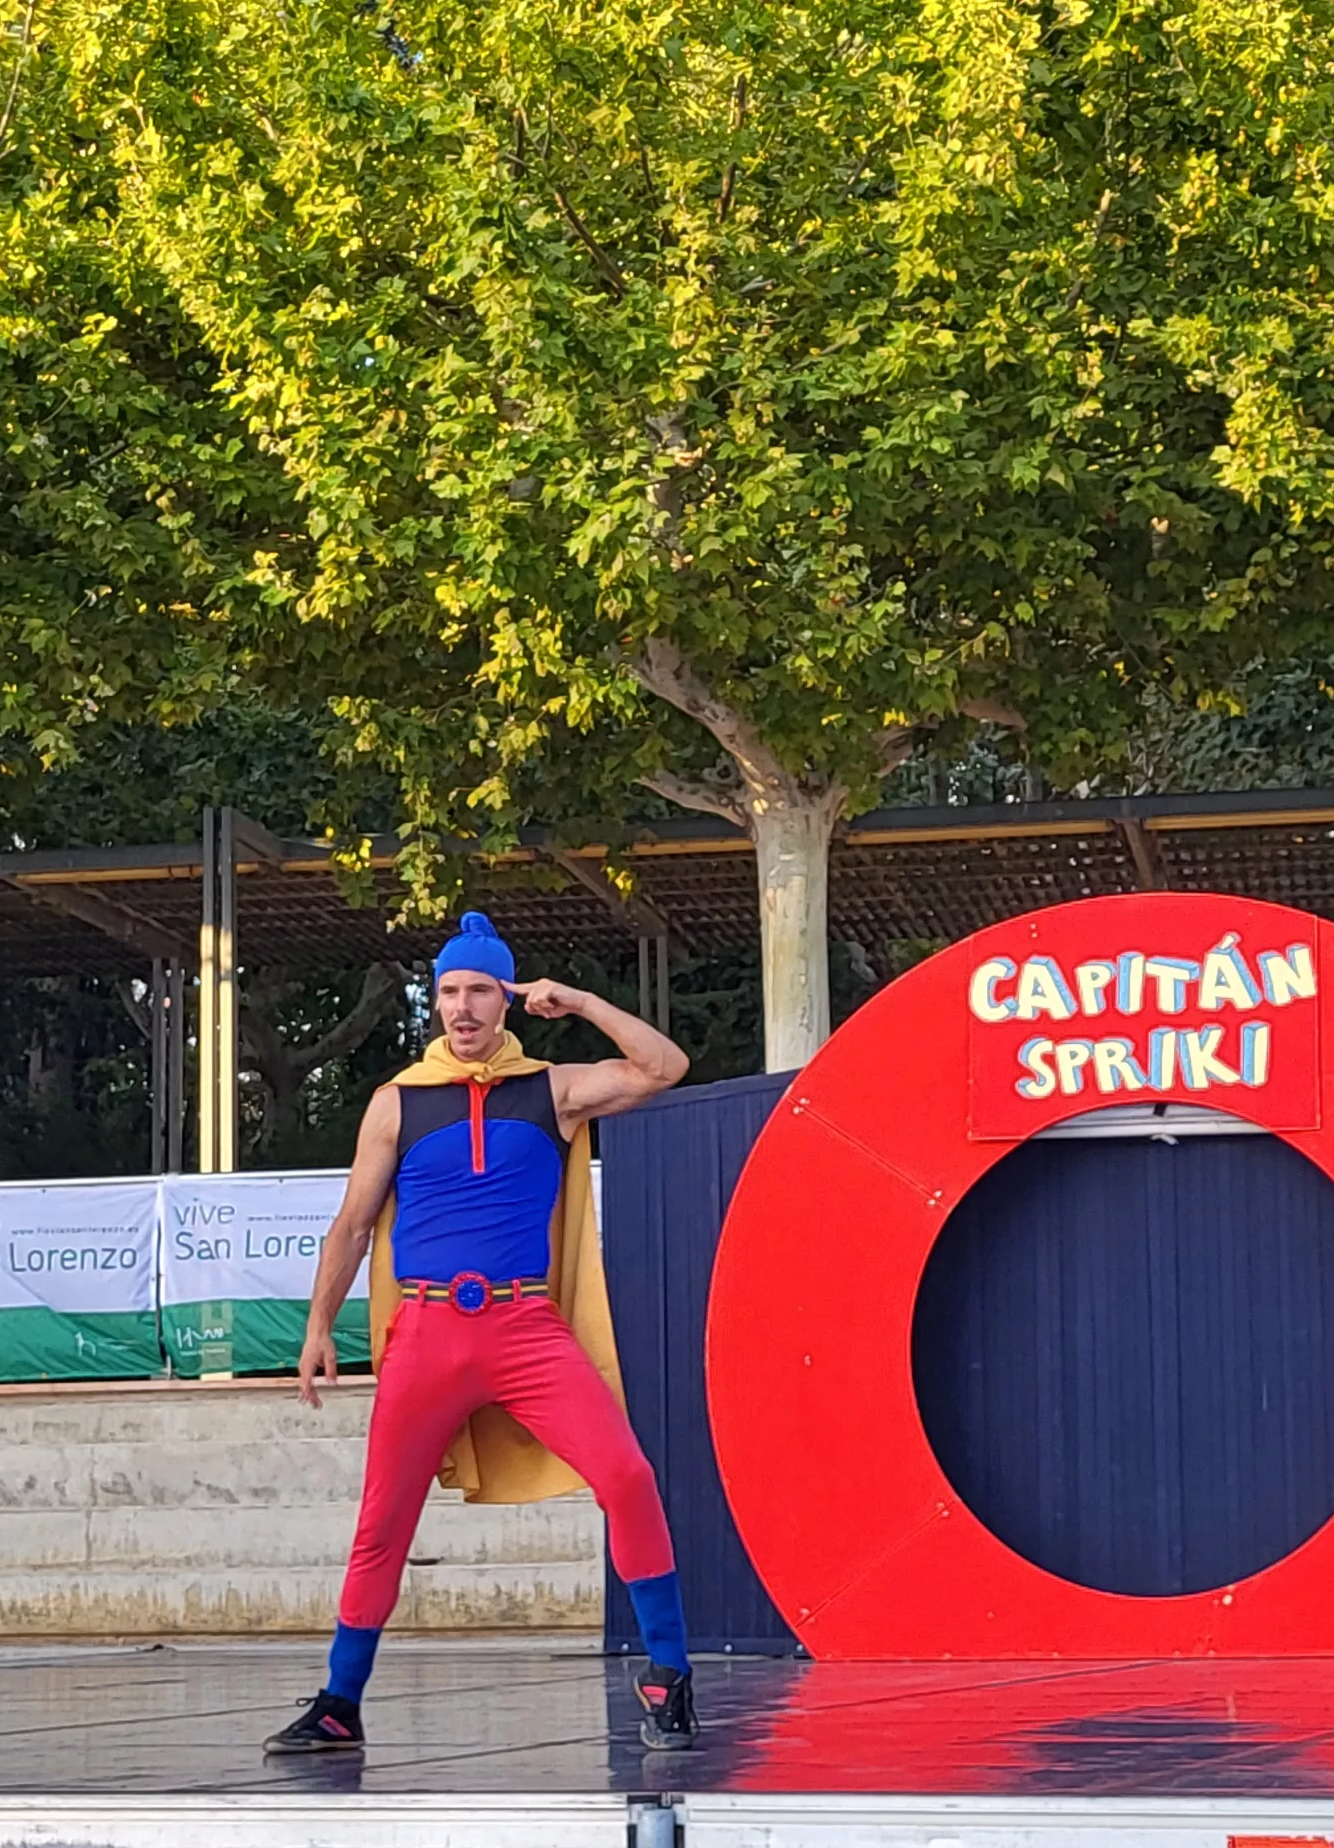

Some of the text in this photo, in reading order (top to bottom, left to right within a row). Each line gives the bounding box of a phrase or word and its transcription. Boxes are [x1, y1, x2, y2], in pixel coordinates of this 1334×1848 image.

[969, 932, 1317, 1023] CAPITÁN
[1015, 1021, 1271, 1099] SPRIKI
[174, 1198, 236, 1226] vive
[9, 1242, 138, 1273] Lorenzo
[175, 1231, 231, 1260] San
